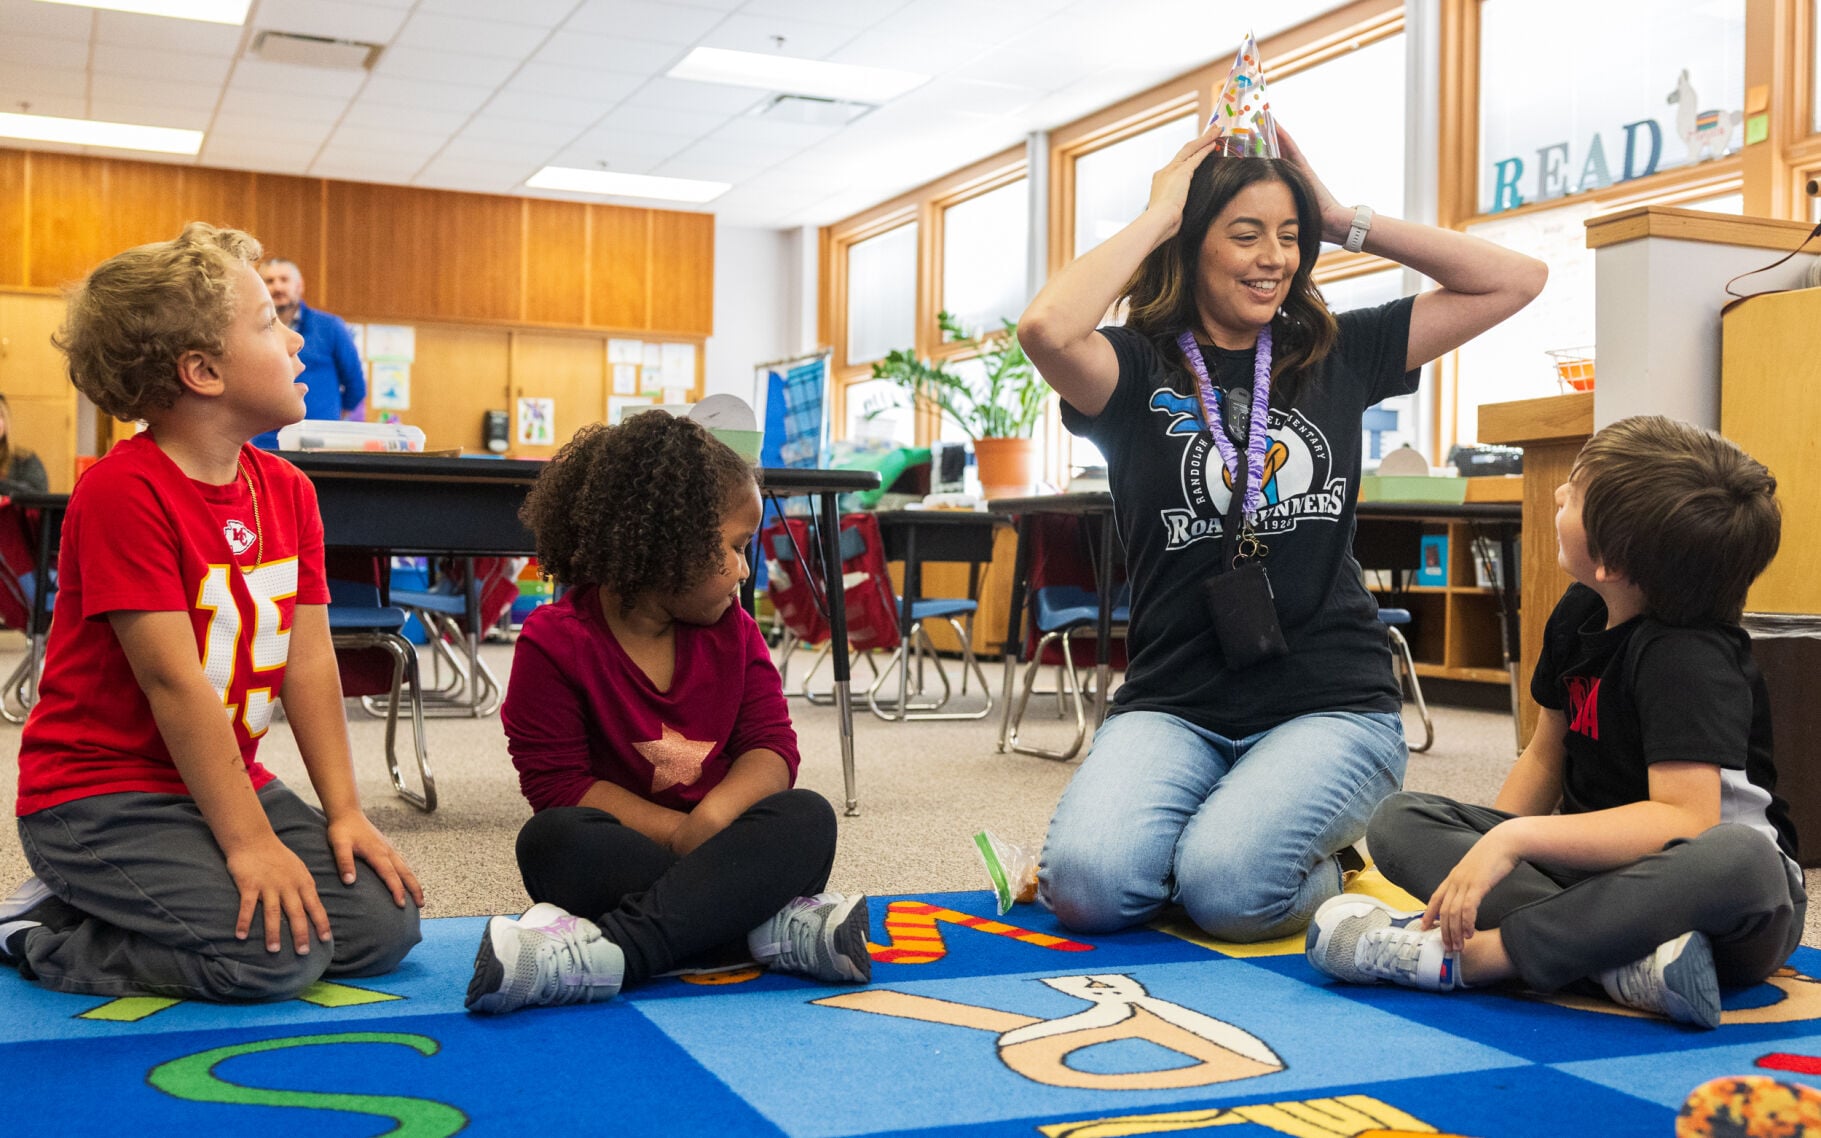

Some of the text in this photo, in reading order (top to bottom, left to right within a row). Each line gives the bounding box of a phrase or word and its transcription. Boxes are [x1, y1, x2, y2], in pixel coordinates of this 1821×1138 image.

[1491, 119, 1662, 213] READ
[1190, 438, 1208, 505] RANDOLPH
[1169, 484, 1343, 544] ROARUNNERS
[196, 555, 298, 738] 15
